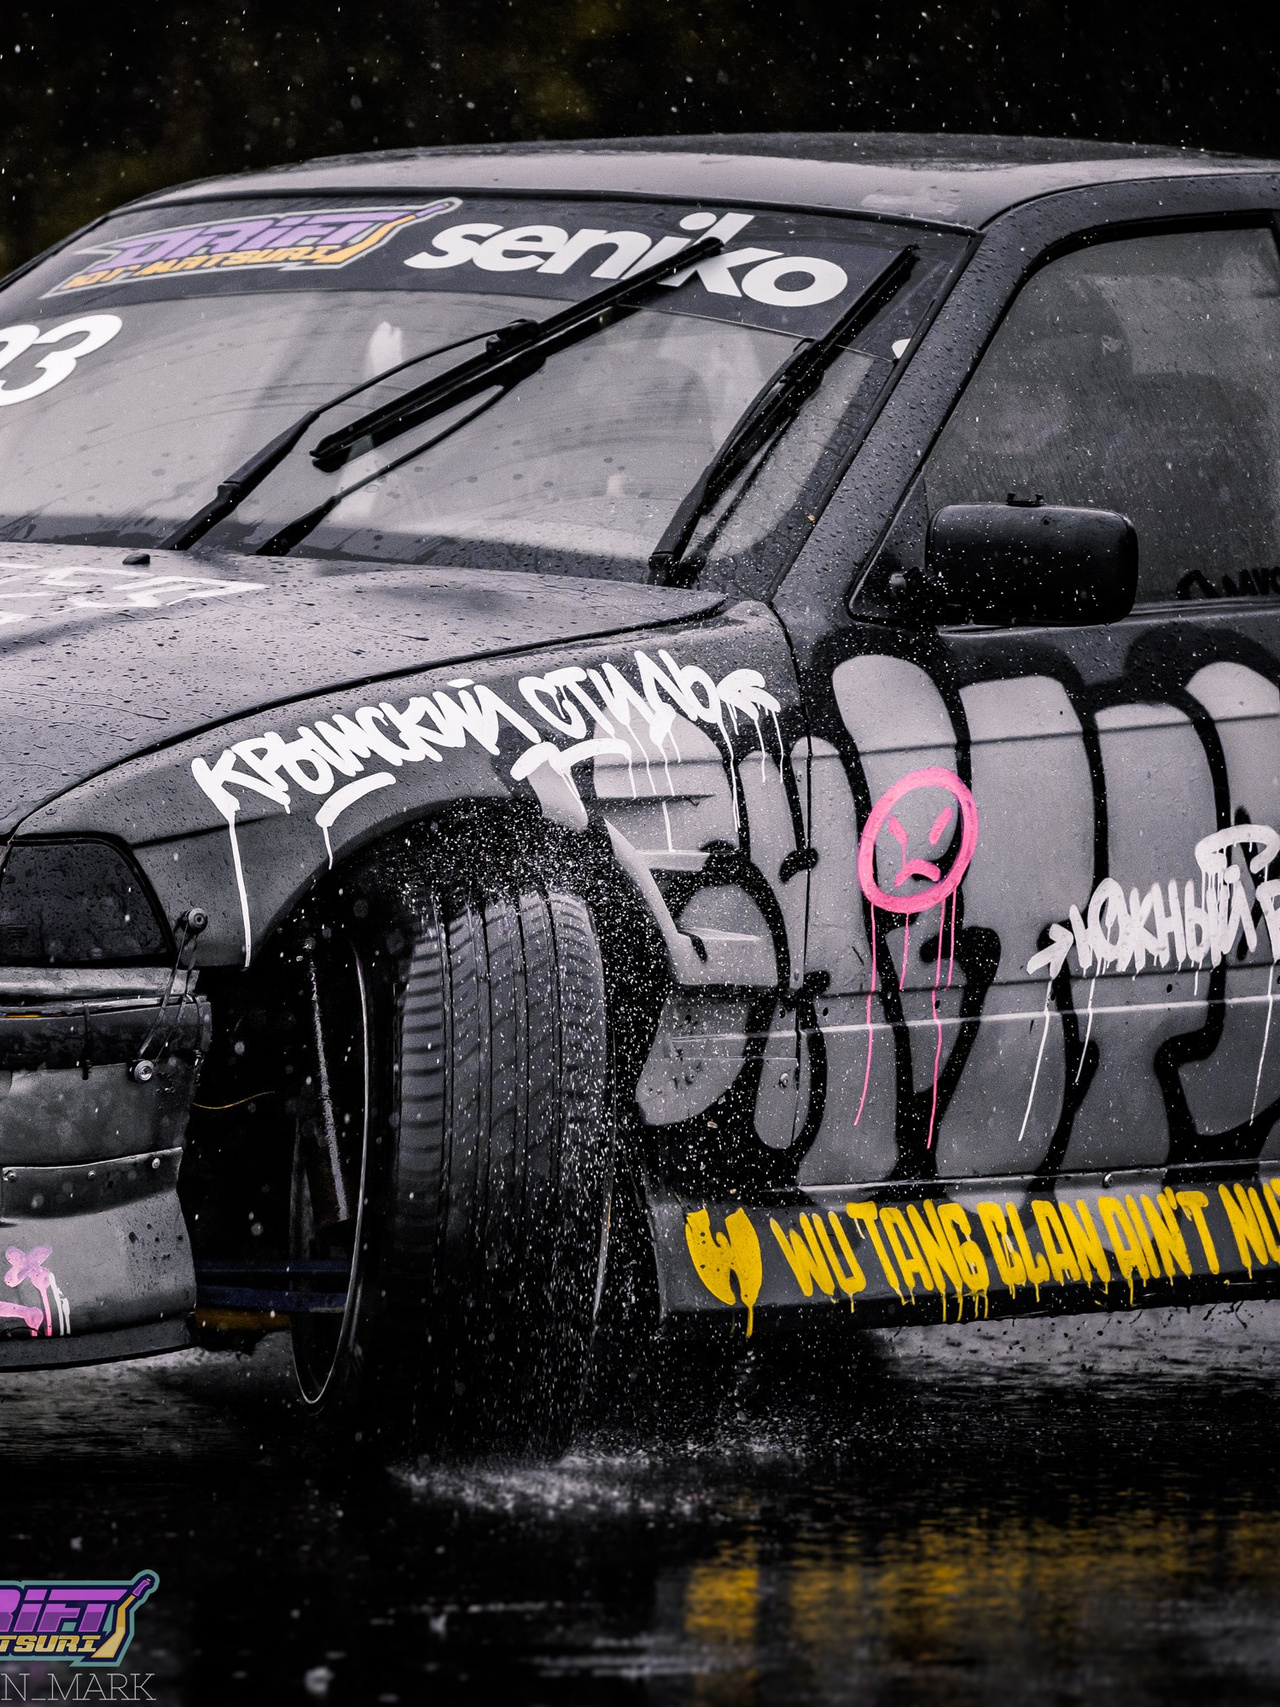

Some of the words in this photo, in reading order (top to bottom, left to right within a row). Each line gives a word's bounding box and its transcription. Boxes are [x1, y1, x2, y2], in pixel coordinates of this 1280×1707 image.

[96, 210, 412, 271] DRIFT
[135, 245, 342, 277] MATSURI
[403, 212, 848, 307] seniko
[769, 1211, 866, 1298] WU
[846, 1198, 990, 1292] TANG
[1097, 1186, 1220, 1280] AIN'T
